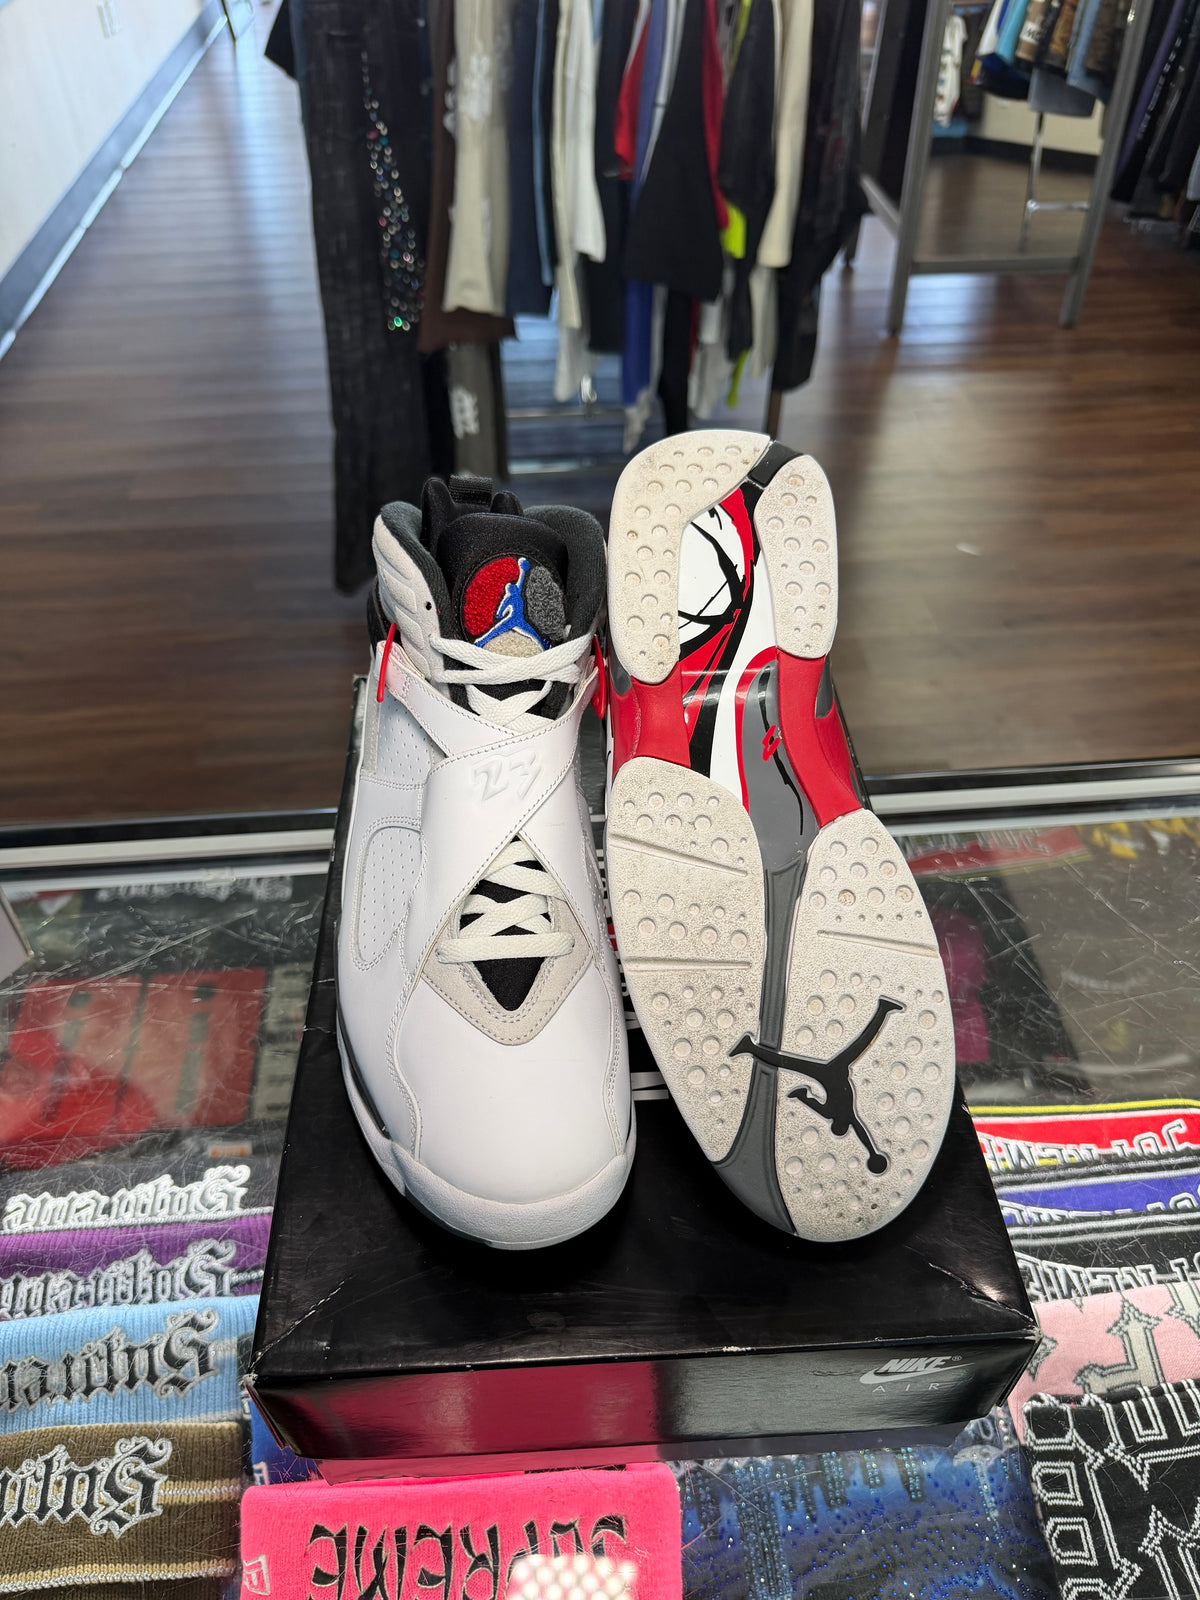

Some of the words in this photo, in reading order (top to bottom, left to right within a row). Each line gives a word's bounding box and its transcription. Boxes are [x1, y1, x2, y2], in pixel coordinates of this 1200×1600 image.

[472, 748, 542, 801] 23
[875, 1356, 951, 1373] NIKE
[872, 1382, 940, 1393] AIR
